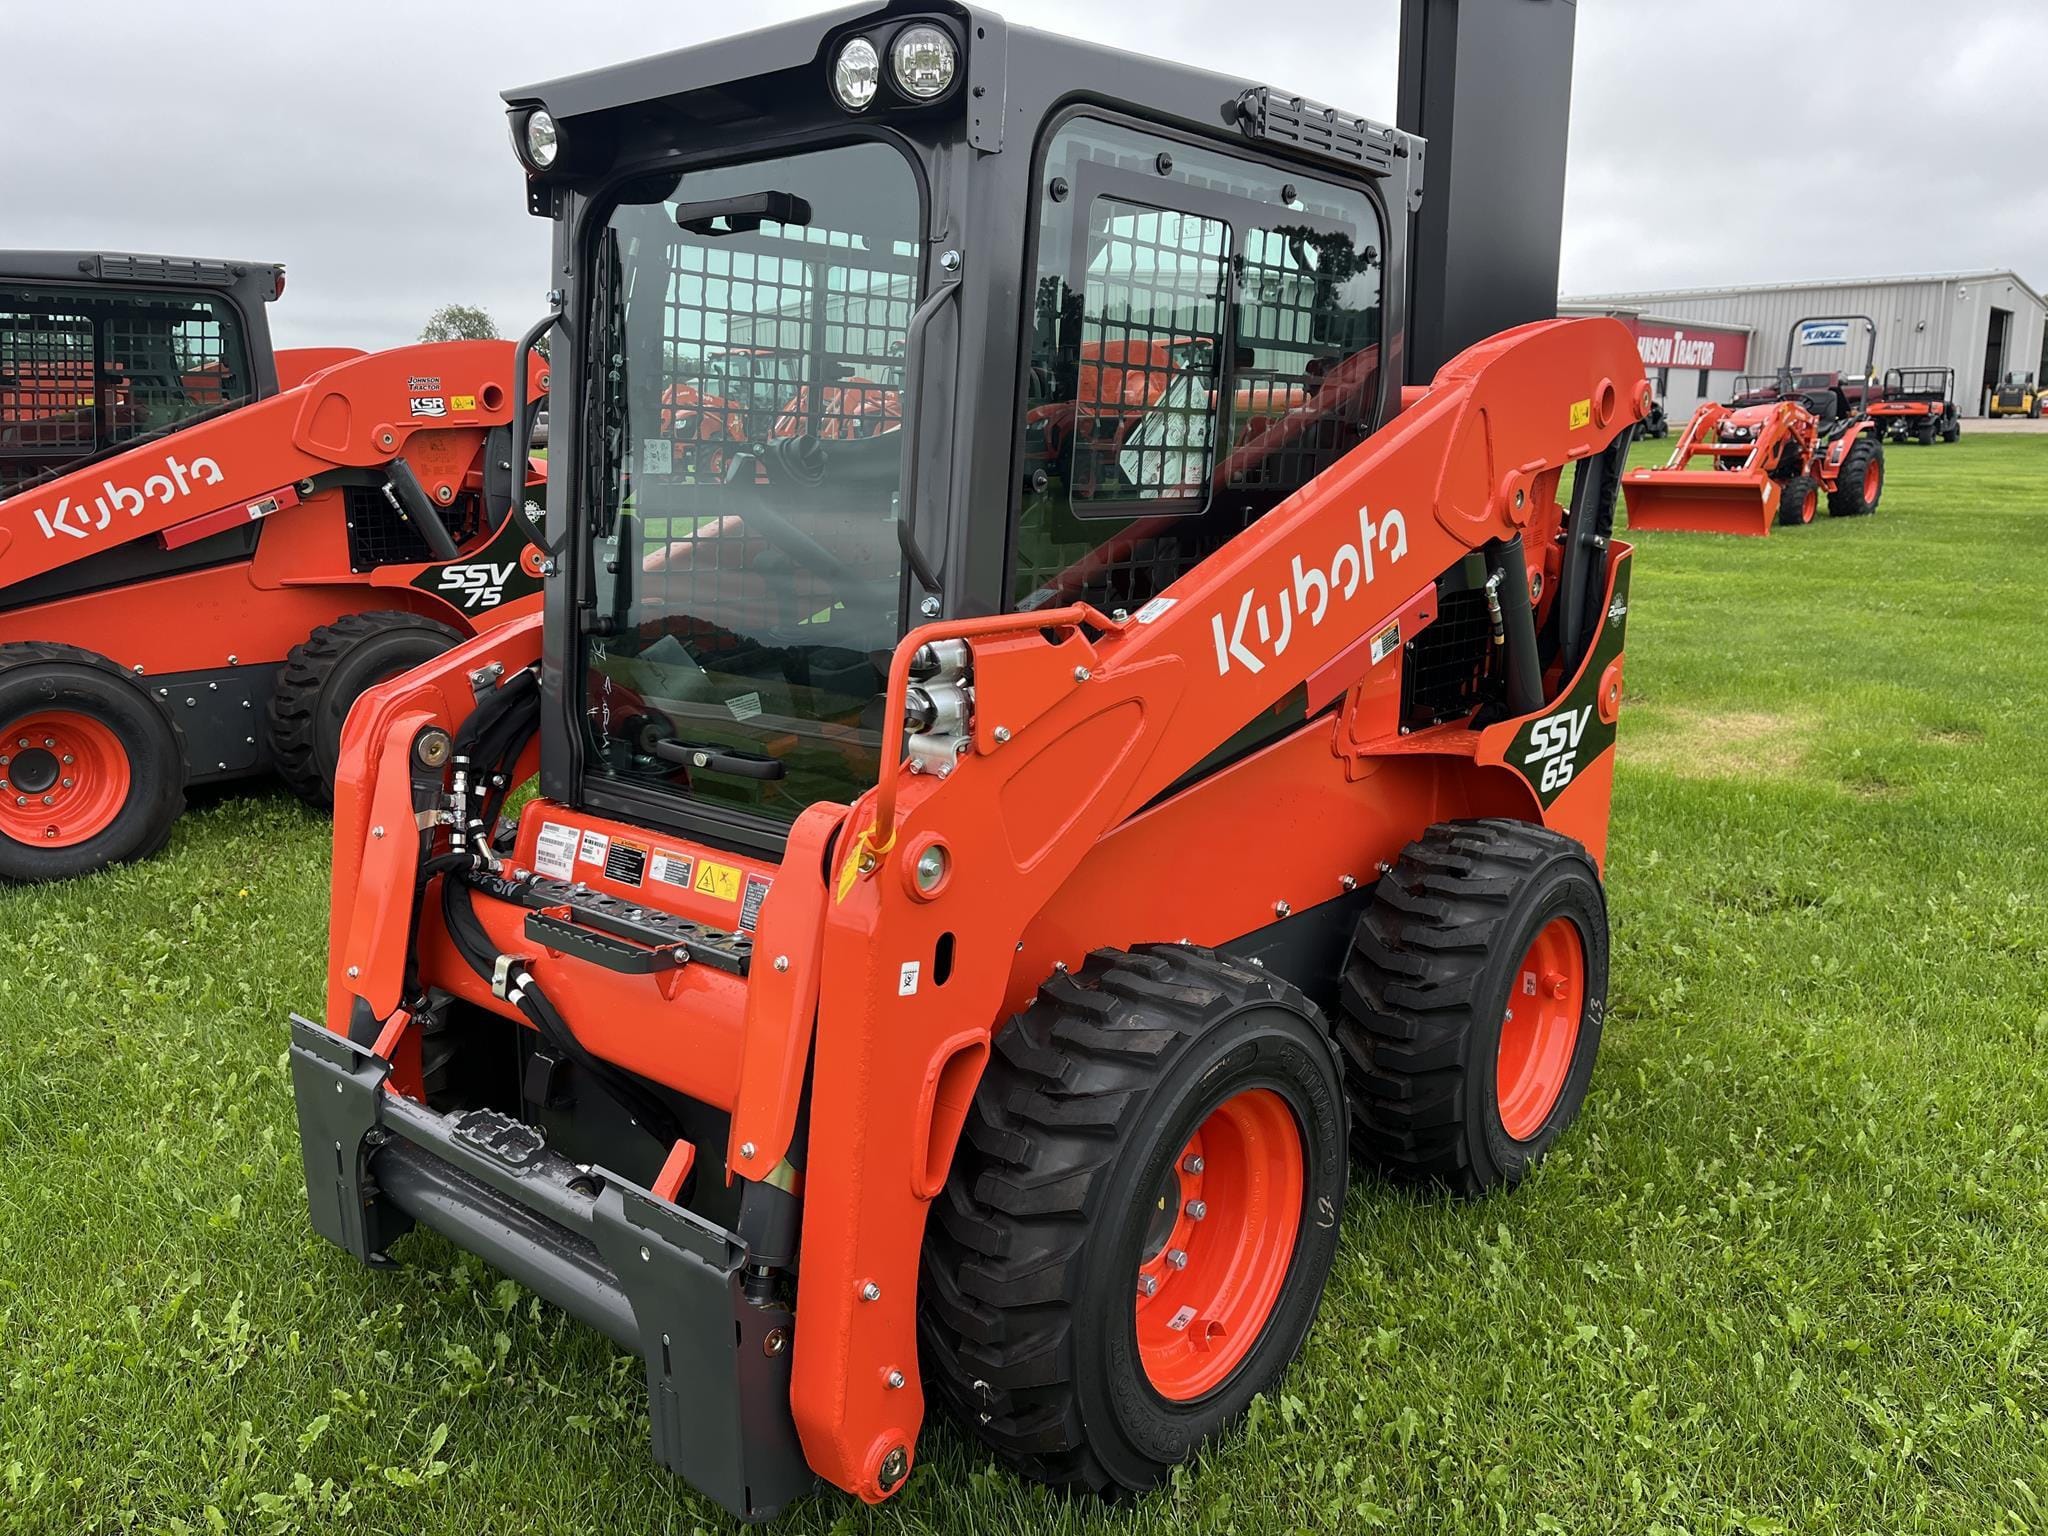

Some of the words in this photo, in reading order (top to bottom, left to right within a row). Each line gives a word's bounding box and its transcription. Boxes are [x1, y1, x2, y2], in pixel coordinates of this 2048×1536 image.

[1673, 331, 1715, 366] TRACTOR
[1803, 329, 1845, 340] KINZE
[407, 376, 440, 384] JOHNSON
[408, 383, 440, 391] TRACTOR
[410, 397, 444, 409] KSR
[33, 456, 225, 540] Kubota
[438, 562, 517, 590] SSV
[464, 586, 503, 608] 75
[1211, 505, 1408, 676] Kubota
[1524, 704, 1593, 765] SSV
[1541, 750, 1577, 793] 65
